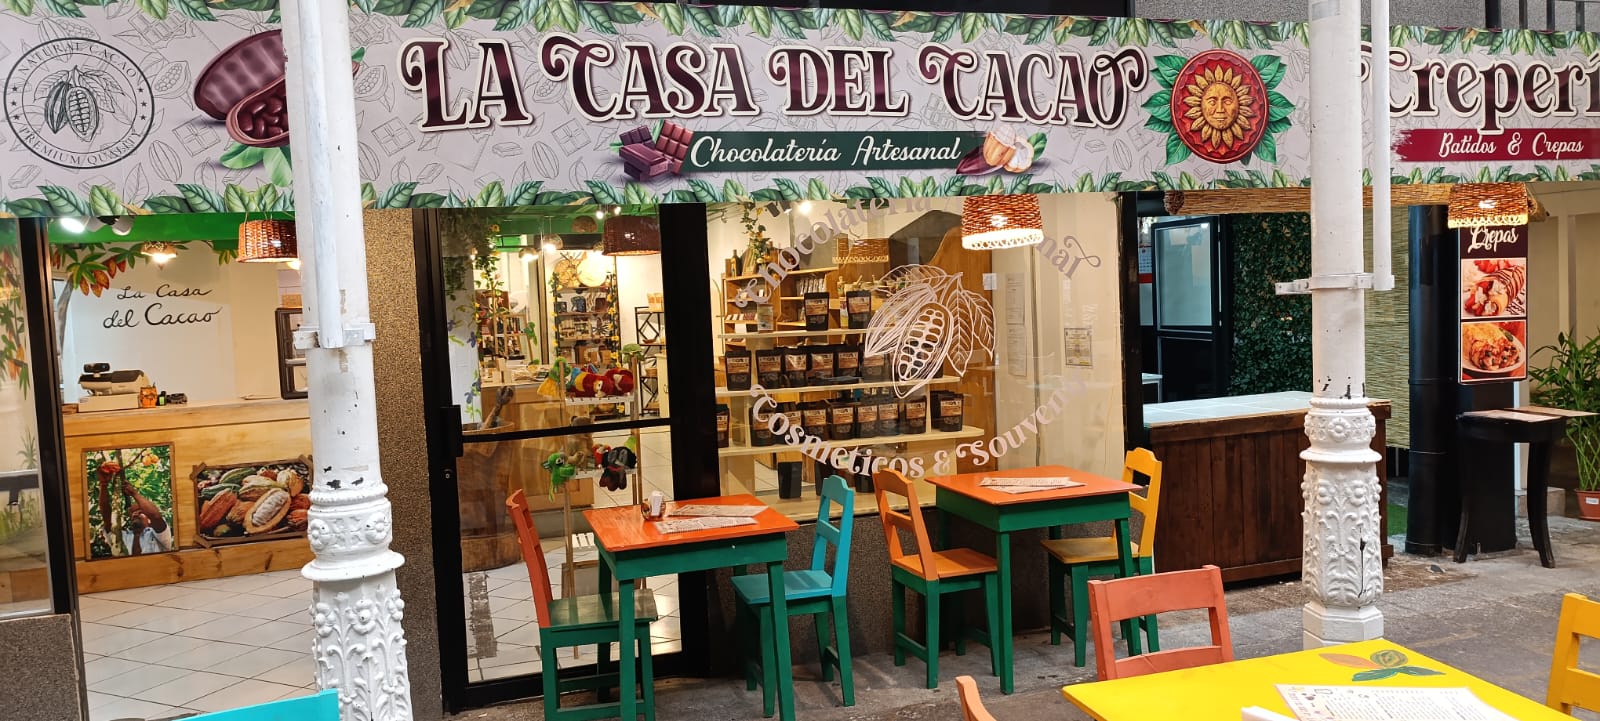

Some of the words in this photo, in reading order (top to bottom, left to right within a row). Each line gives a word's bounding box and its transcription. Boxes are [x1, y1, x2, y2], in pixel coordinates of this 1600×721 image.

[18, 42, 82, 76] NATURAL
[89, 45, 137, 78] CACAO
[399, 38, 533, 132] LA
[542, 33, 760, 120] CASA
[768, 47, 910, 117] DEL
[917, 42, 1148, 128] CACAO
[19, 127, 80, 164] PREMIUM
[87, 128, 142, 165] QUALITY
[690, 135, 841, 168] Chocolatería
[851, 135, 961, 166] Artesanal
[1438, 132, 1497, 157] Batidos
[1507, 131, 1523, 156] &
[1532, 132, 1585, 160] Crepas
[1467, 224, 1519, 253] Crepas
[116, 285, 146, 300] La
[155, 284, 213, 298] Casa
[102, 308, 141, 329] del
[144, 302, 223, 326] Cacao
[933, 449, 951, 476] &
